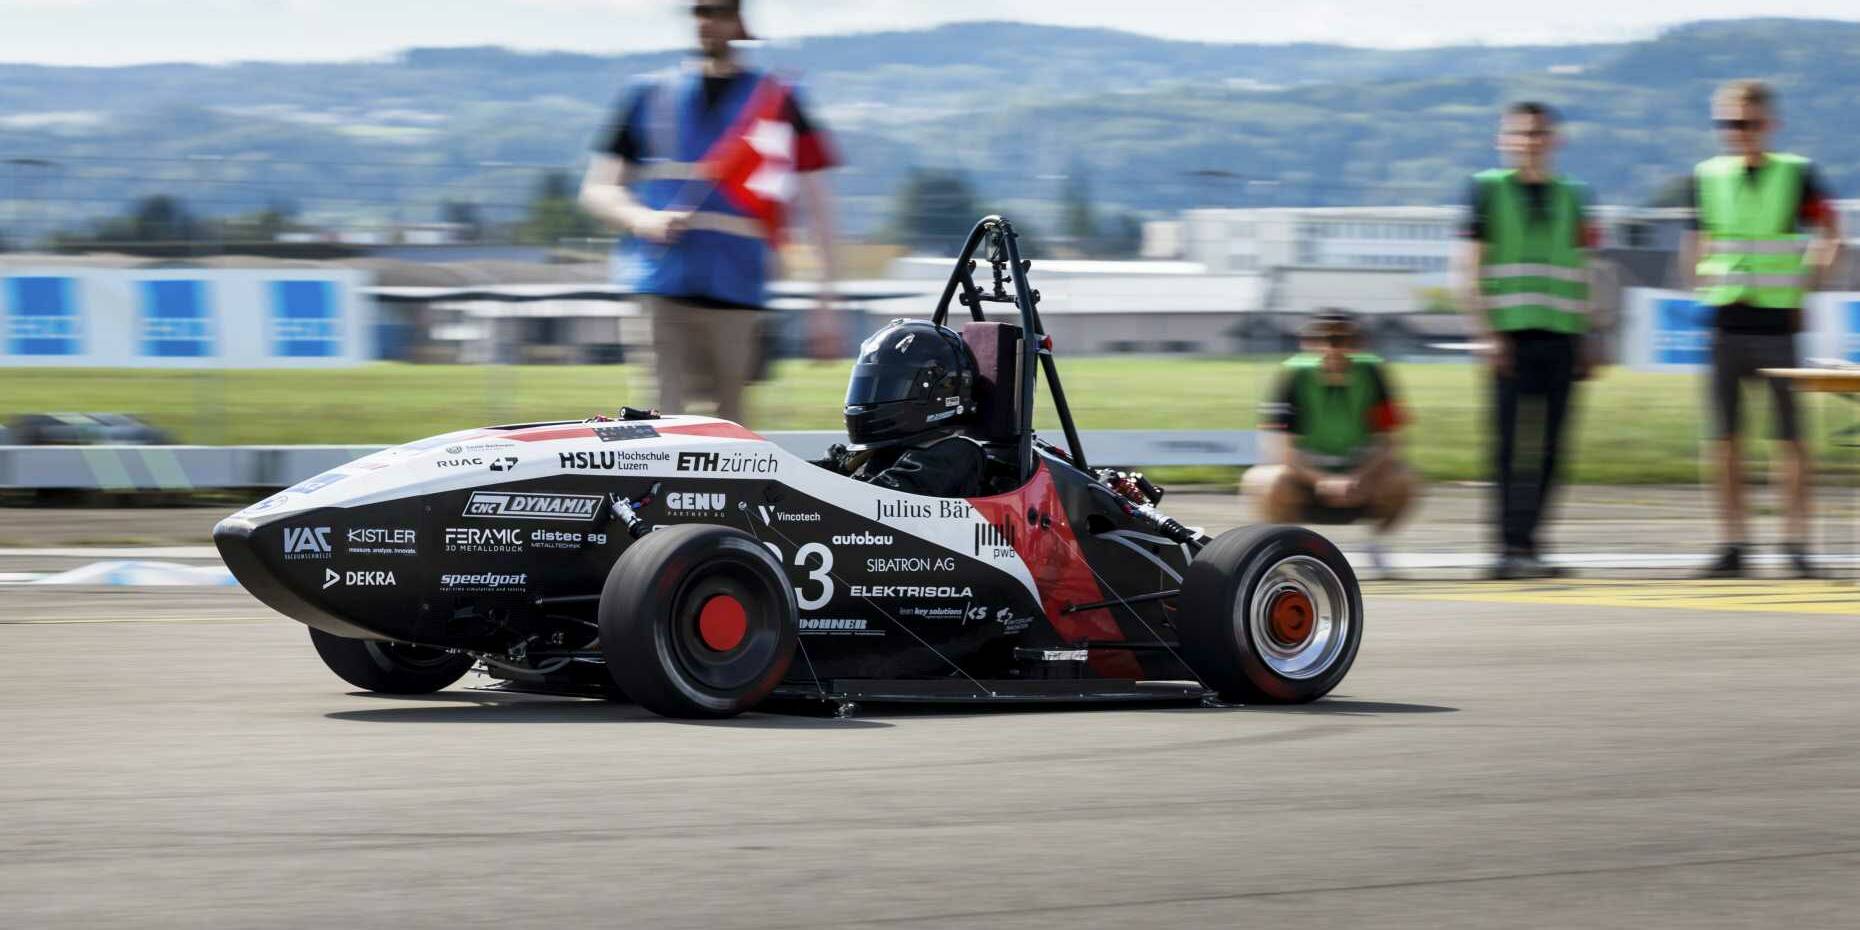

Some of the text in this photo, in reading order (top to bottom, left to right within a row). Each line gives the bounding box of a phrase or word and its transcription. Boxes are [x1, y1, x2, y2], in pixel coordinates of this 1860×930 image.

[558, 451, 615, 469] HSLU
[617, 451, 670, 461] Hochschule
[677, 452, 778, 472] ETH zürich
[617, 462, 648, 470] Luzern
[471, 503, 497, 514] CNC
[511, 496, 595, 514] DYNAMIX
[666, 493, 726, 510] GENU
[777, 511, 820, 521] Vincotech
[875, 500, 973, 521] Julius Bär
[284, 527, 332, 553] VAC
[347, 529, 416, 543] KISTLER
[446, 528, 523, 544] FERAMIC
[531, 529, 607, 544] distec ag
[832, 531, 893, 545] autobau
[867, 558, 955, 572] SIBATRON AG
[345, 571, 397, 586] DEKRA
[440, 572, 527, 587] speedgoat
[850, 586, 973, 598] ELEKTRISOLA
[915, 608, 928, 616] key
